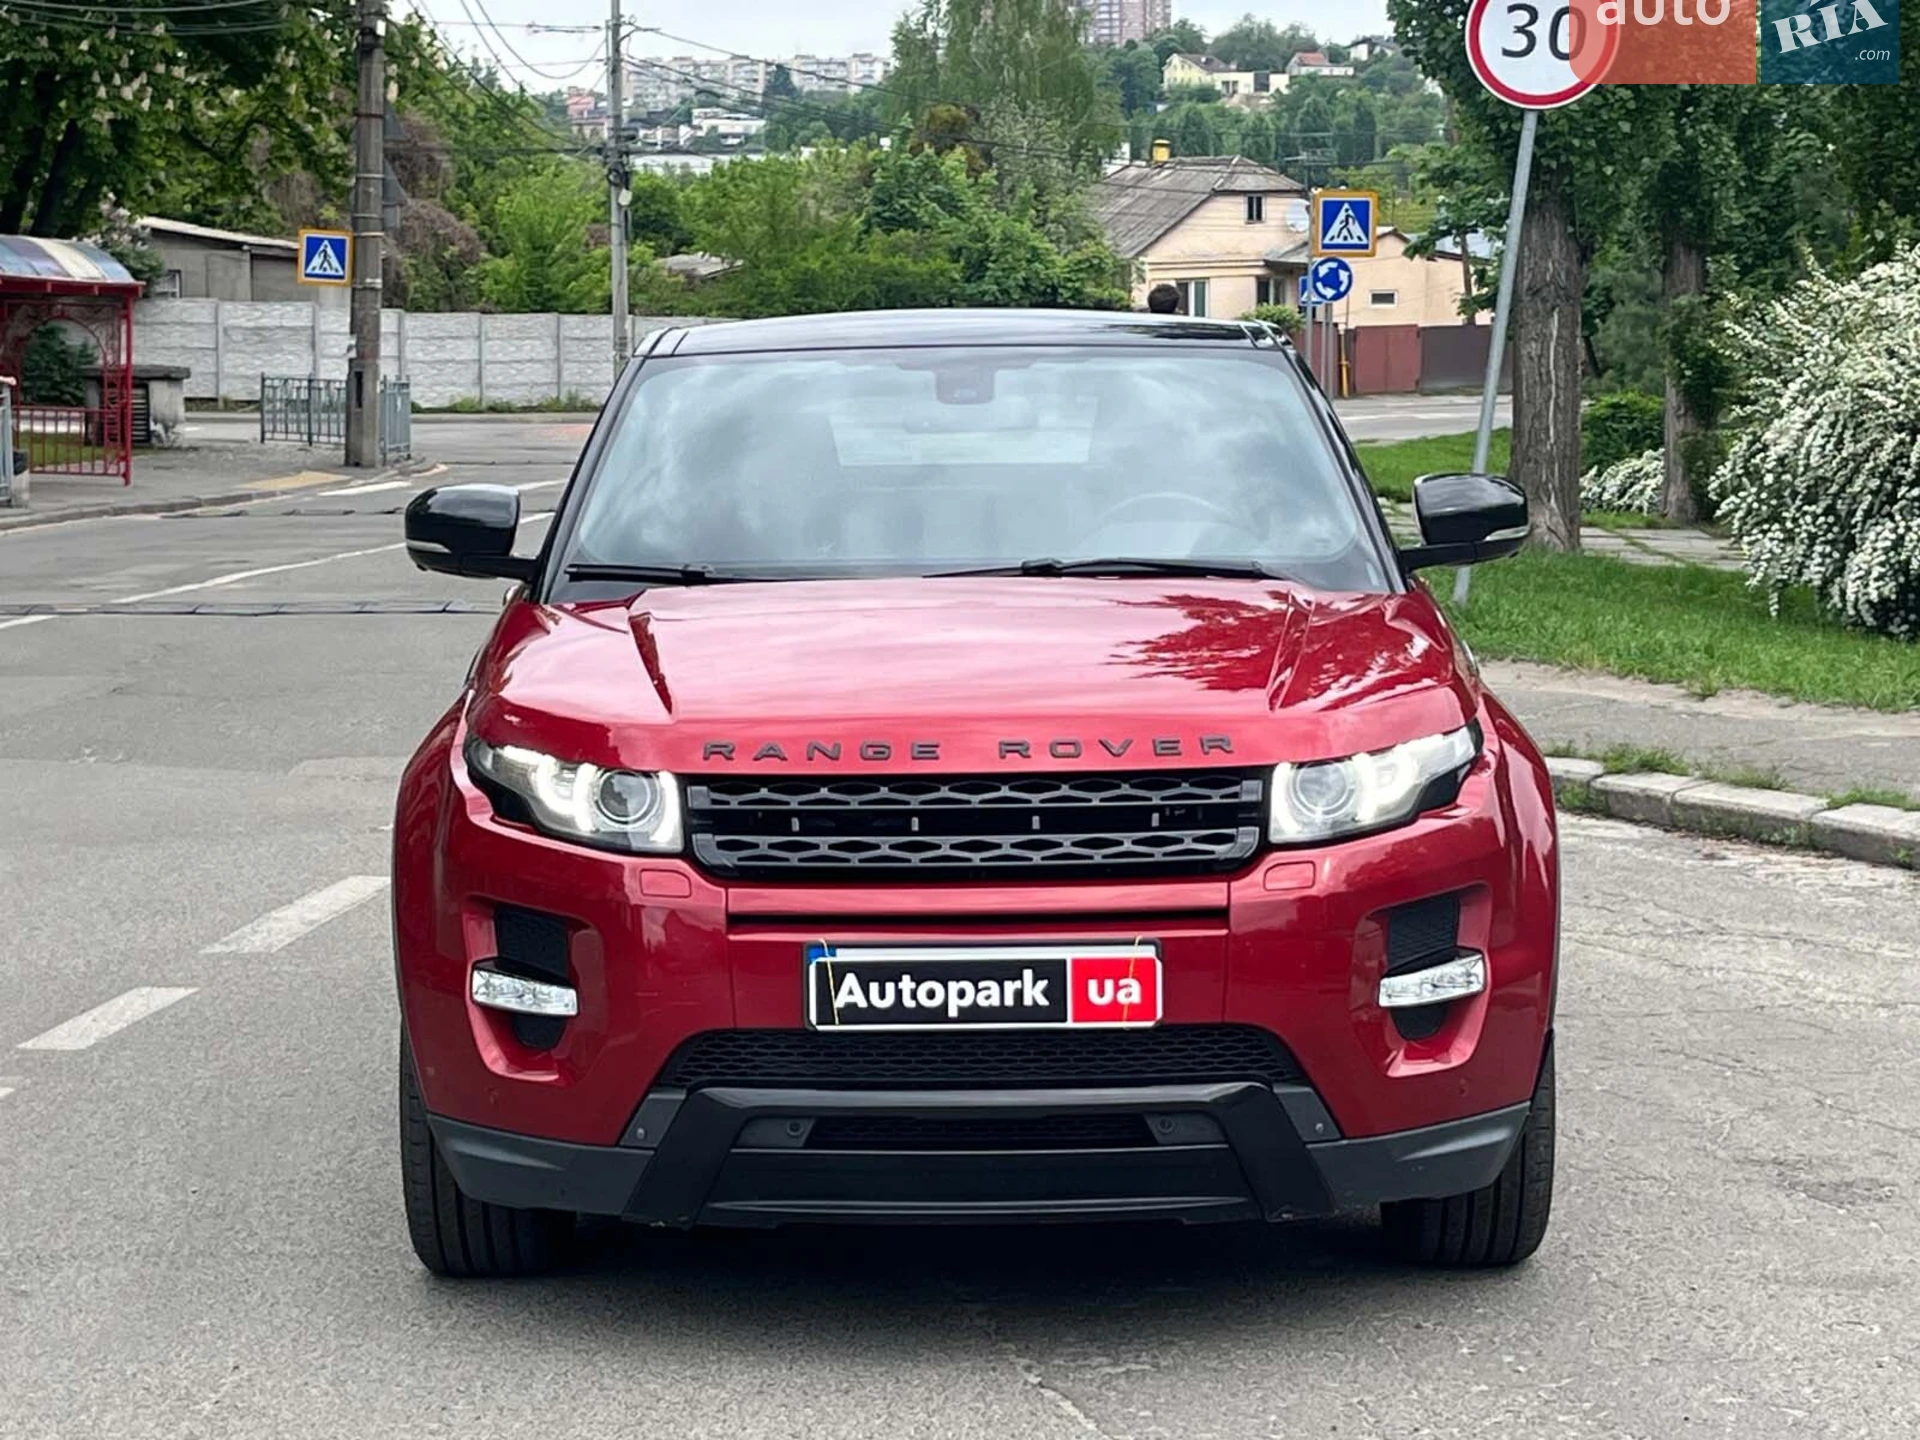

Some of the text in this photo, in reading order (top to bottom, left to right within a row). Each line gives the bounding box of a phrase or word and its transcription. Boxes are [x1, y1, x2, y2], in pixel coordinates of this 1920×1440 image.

[1501, 3, 1587, 61] 30
[702, 734, 1235, 762] RANGE ROVER
[834, 968, 1142, 1018] Autopark ua
